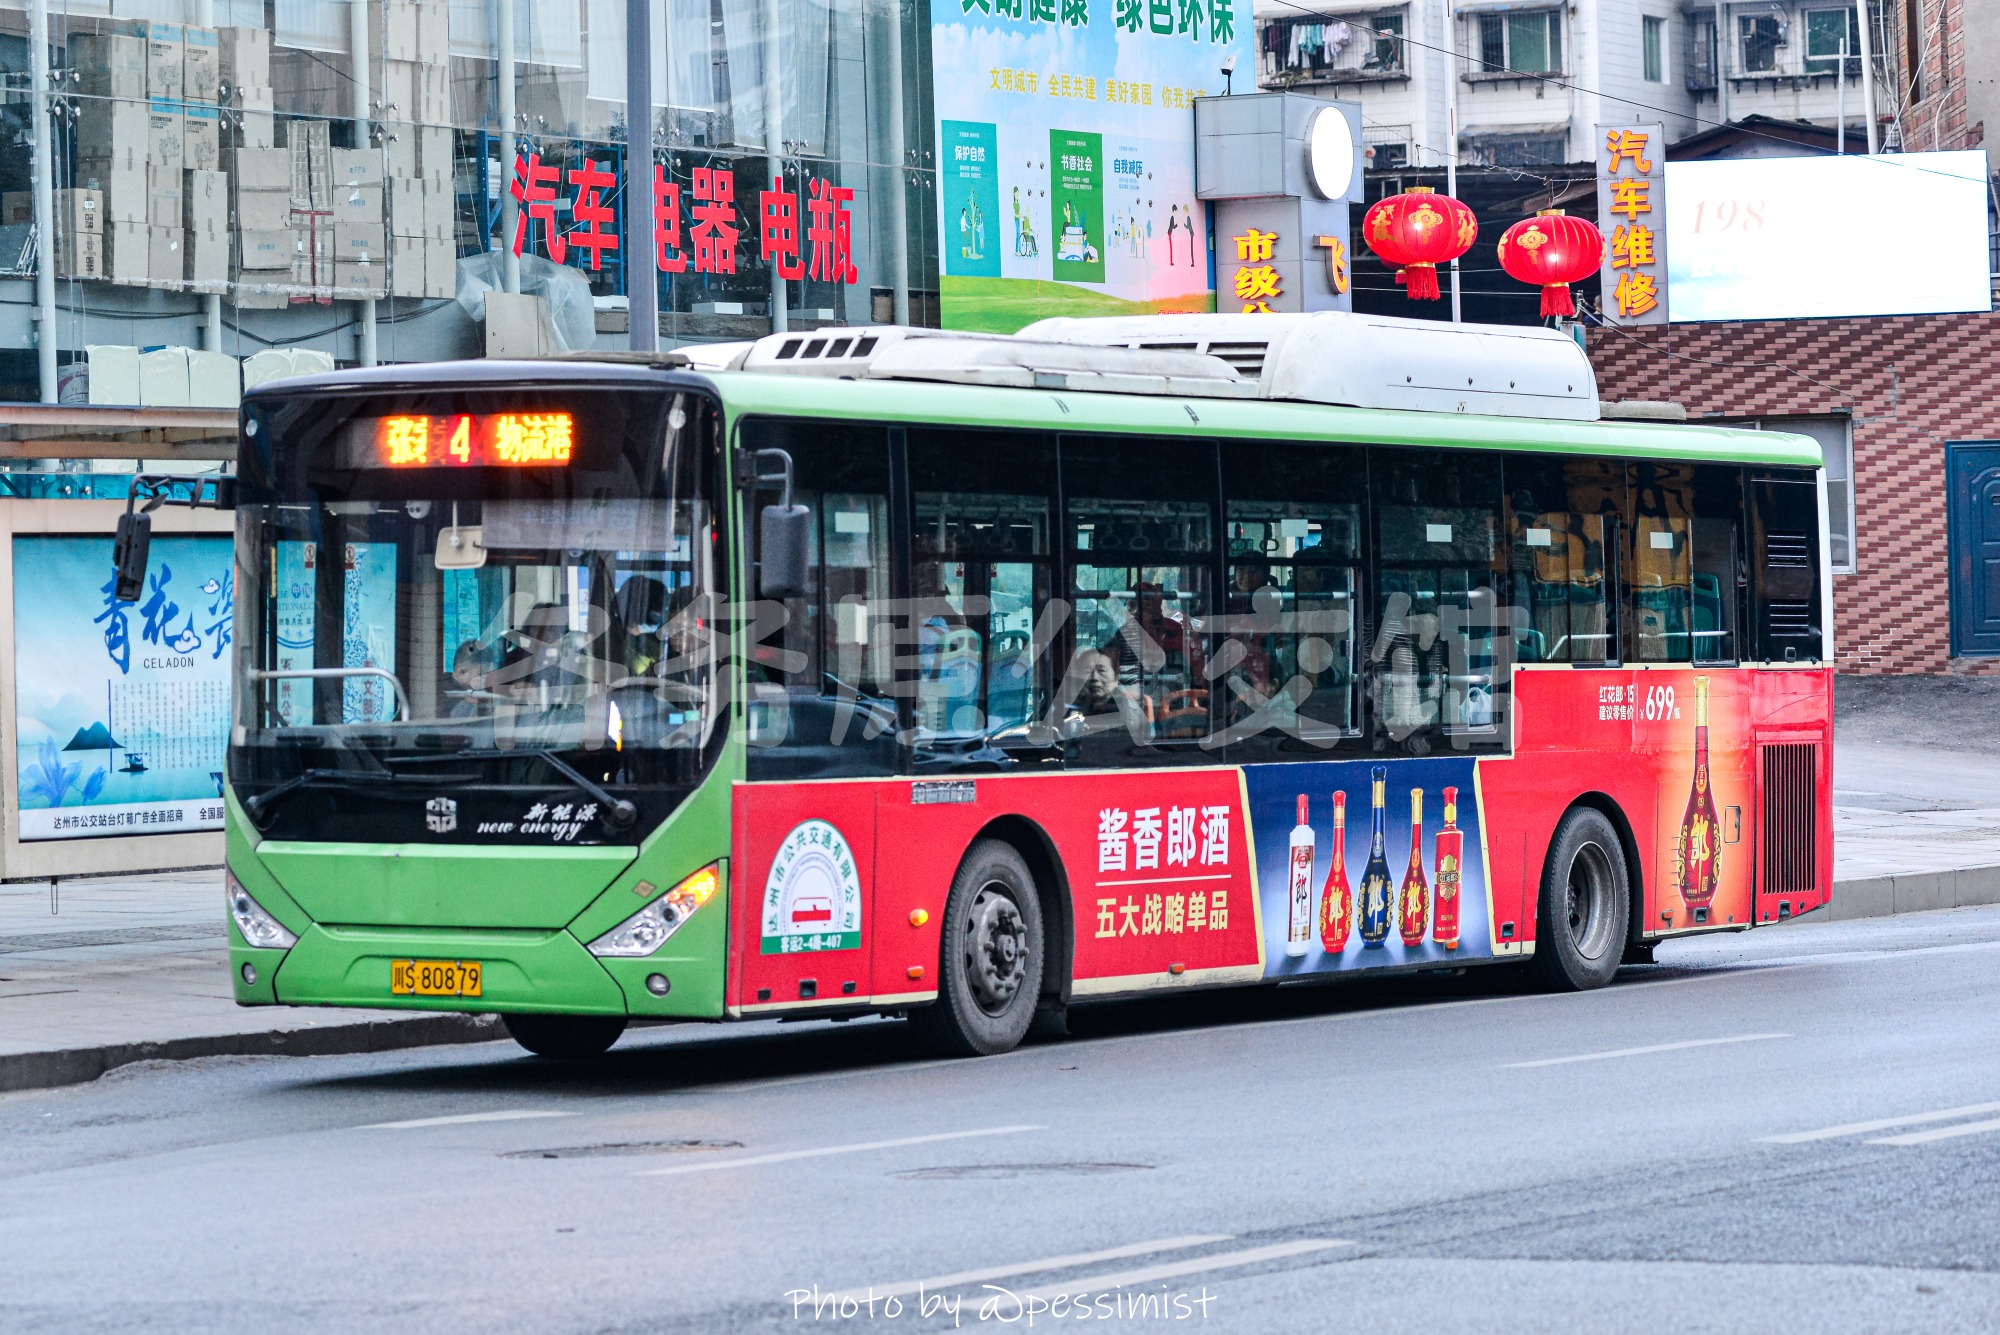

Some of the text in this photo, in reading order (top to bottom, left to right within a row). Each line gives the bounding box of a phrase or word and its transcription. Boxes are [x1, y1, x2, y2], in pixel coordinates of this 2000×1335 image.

[989, 66, 1038, 94] 文明城市
[1048, 73, 1097, 101] 全民共建
[1105, 79, 1153, 106] 美好家园
[954, 145, 985, 162] 保护自然
[1061, 154, 1093, 172] 书香社会
[1113, 158, 1143, 175] 自我减压
[509, 153, 618, 271] 汽车
[759, 175, 858, 285] 电瓶
[1605, 129, 1659, 318] 汽车维修
[1692, 199, 1766, 234] 198
[1318, 235, 1349, 294] 飞
[450, 416, 470, 463] 4
[496, 415, 572, 463] 物流港
[143, 657, 195, 669] CELADON
[1598, 704, 1634, 721] 建议零售价
[54, 808, 184, 830] 达州市公交站台灯箱广告全面招商
[523, 802, 598, 821] 新能源
[477, 820, 584, 841] new energy
[1097, 804, 1230, 873] 酱香郎酒
[768, 826, 858, 933] 达州市公共交通有限公司
[1095, 890, 1229, 939] 五大战略单品
